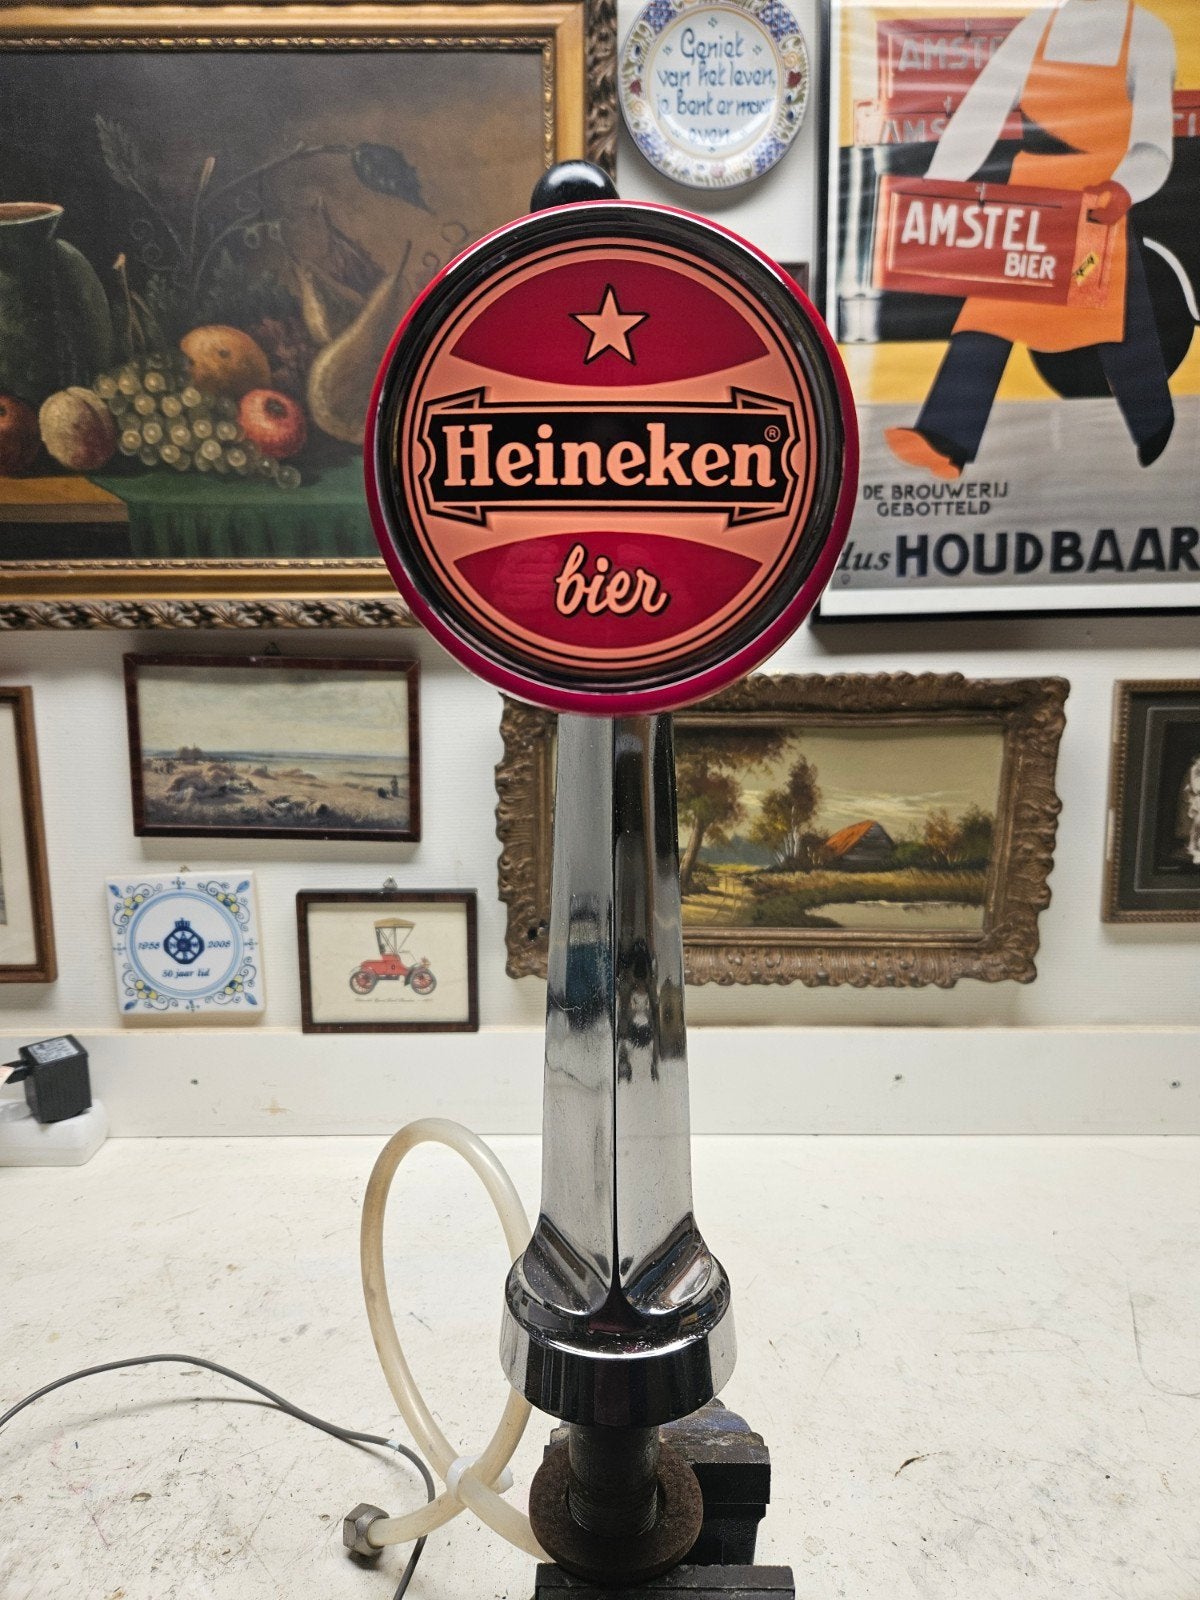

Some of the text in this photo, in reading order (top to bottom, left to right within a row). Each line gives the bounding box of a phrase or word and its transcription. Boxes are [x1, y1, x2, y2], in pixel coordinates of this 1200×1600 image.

[680, 27, 744, 64] Geniet
[898, 36, 1003, 71] AMST
[656, 69, 691, 87] van
[698, 60, 726, 86] het
[677, 88, 713, 115] bent
[901, 201, 1046, 253] AMSTEL
[1004, 252, 1056, 280] BIER
[441, 422, 777, 488] Heineken
[863, 482, 1008, 500] DE BROUWERIJ
[877, 501, 991, 517] GEBOTTELD
[896, 527, 1200, 577] HOUDBAAR
[555, 543, 669, 616] bier
